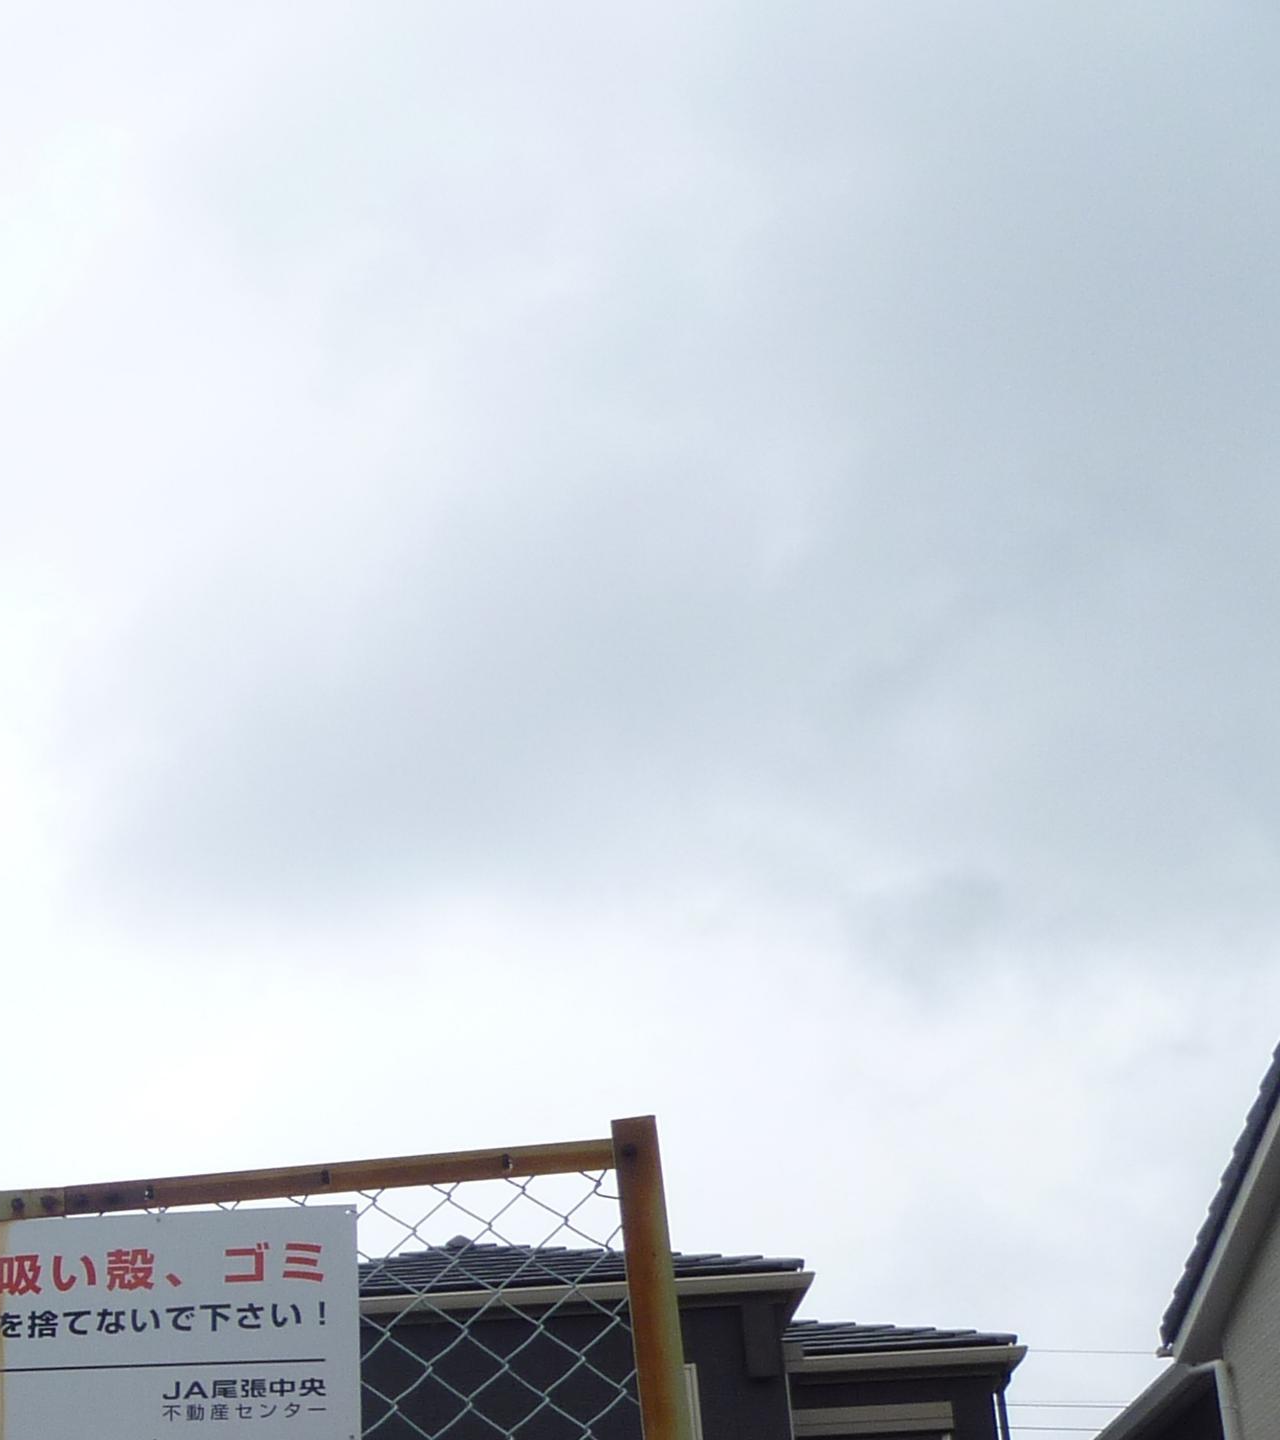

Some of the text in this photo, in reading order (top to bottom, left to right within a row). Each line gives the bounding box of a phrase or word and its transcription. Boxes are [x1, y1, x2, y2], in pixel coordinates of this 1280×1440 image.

[162, 1377, 327, 1401] JA尾張中央
[162, 1402, 327, 1422] 不動産センター
